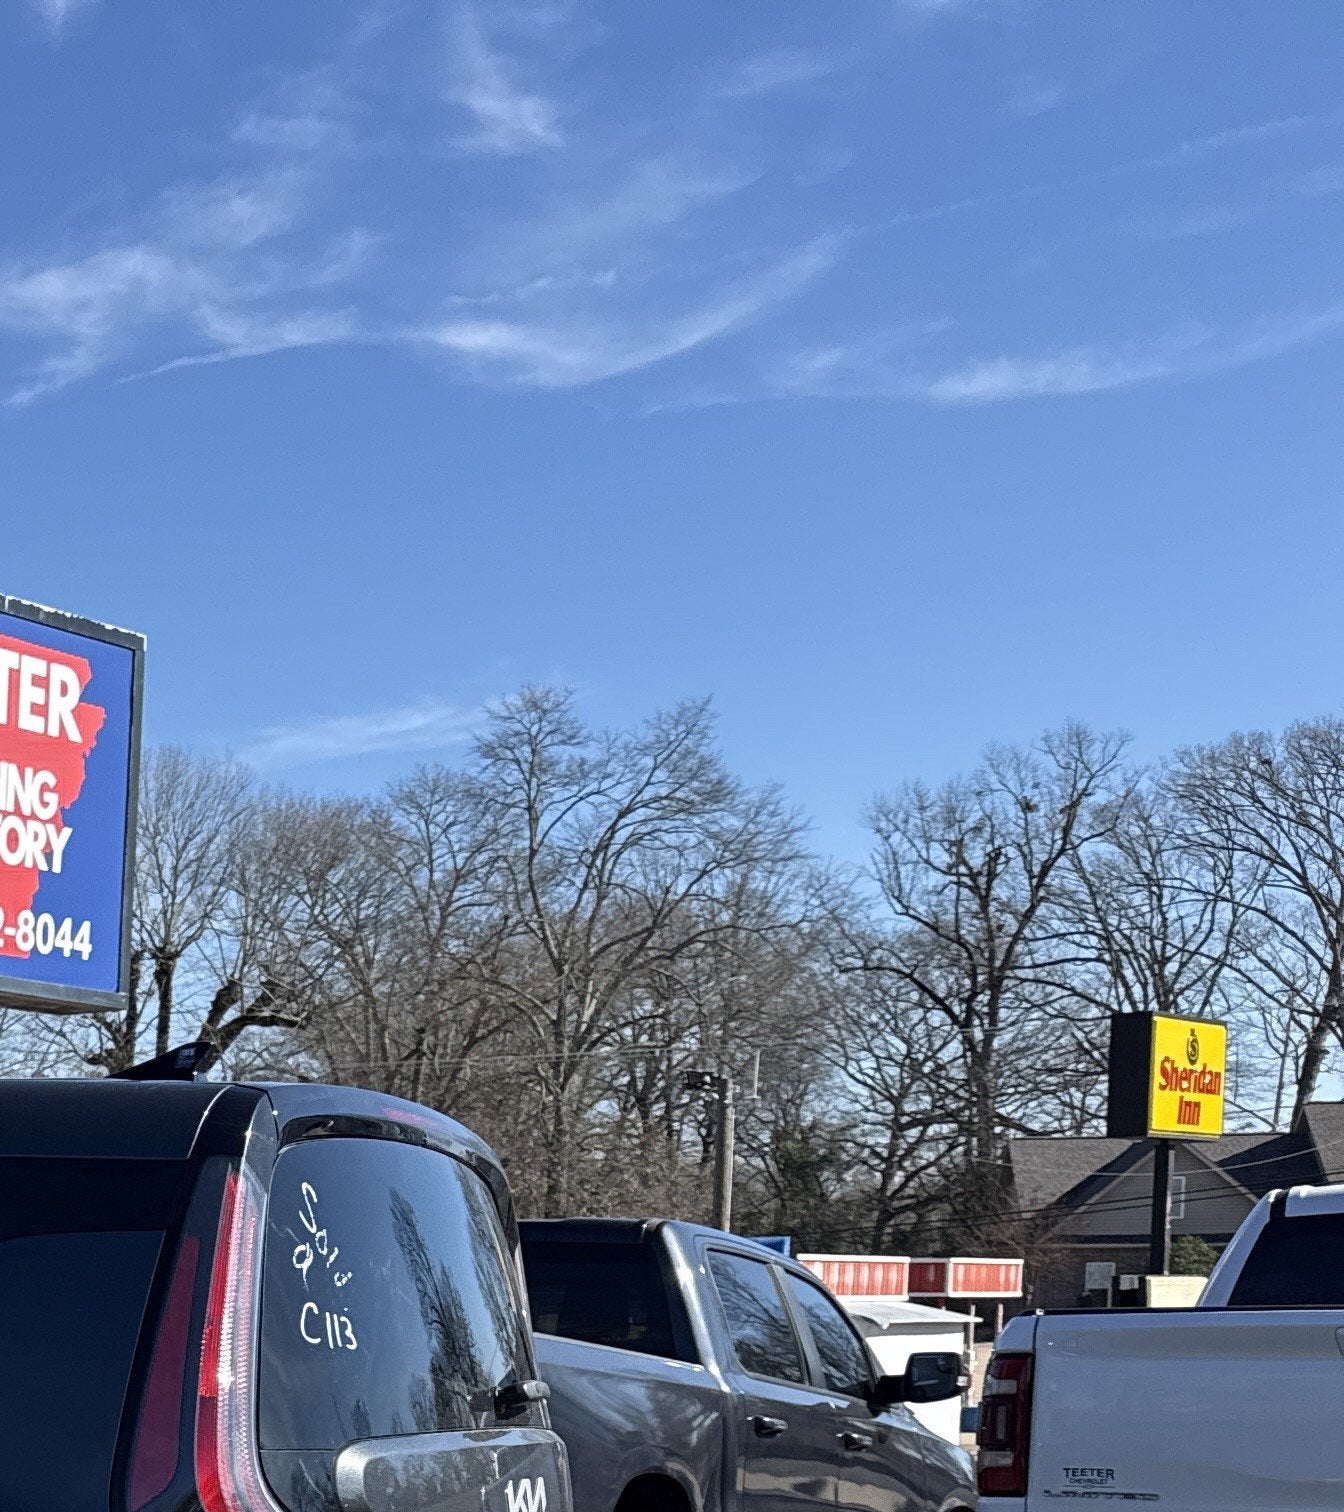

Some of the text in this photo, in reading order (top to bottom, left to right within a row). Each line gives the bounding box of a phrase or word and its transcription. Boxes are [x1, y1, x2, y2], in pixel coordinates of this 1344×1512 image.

[1158, 1055, 1222, 1096] Sheridan
[300, 1301, 358, 1350] C113
[1063, 1467, 1114, 1481] TEETER
